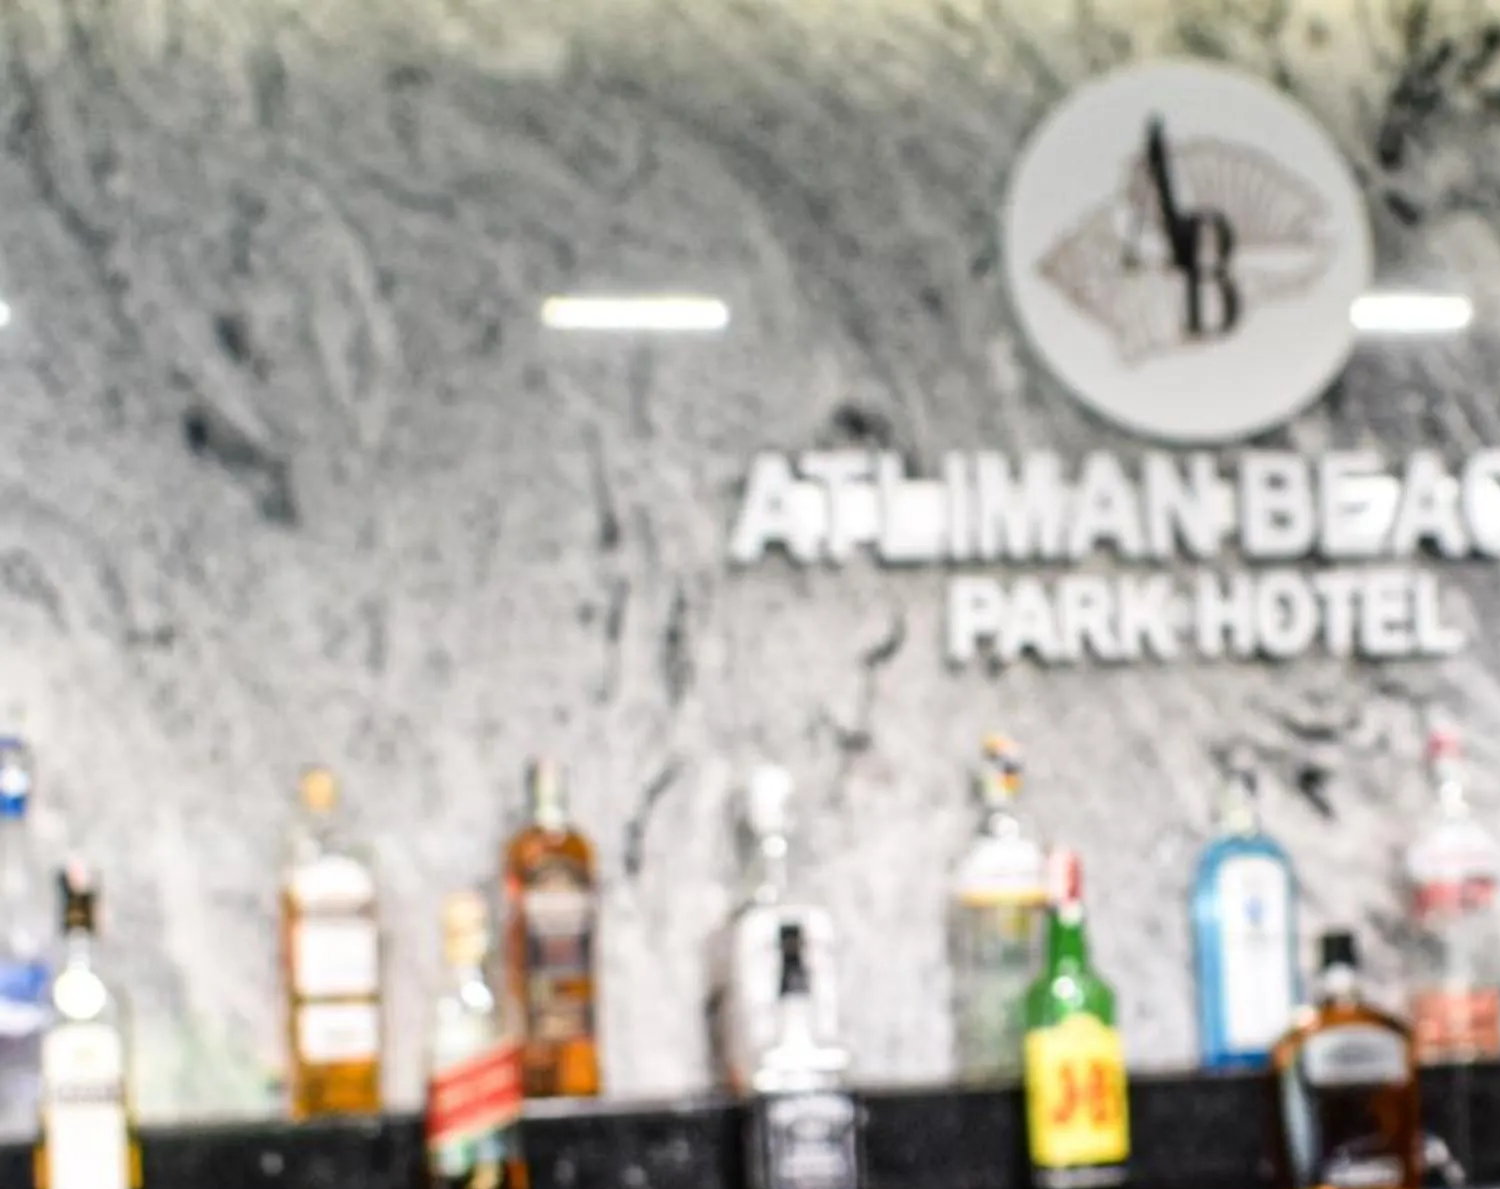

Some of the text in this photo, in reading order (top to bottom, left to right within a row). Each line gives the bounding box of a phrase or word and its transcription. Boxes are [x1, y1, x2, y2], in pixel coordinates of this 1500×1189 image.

[729, 449, 1224, 563] ATLIMAN
[948, 569, 1465, 661] PARK HOTEL
